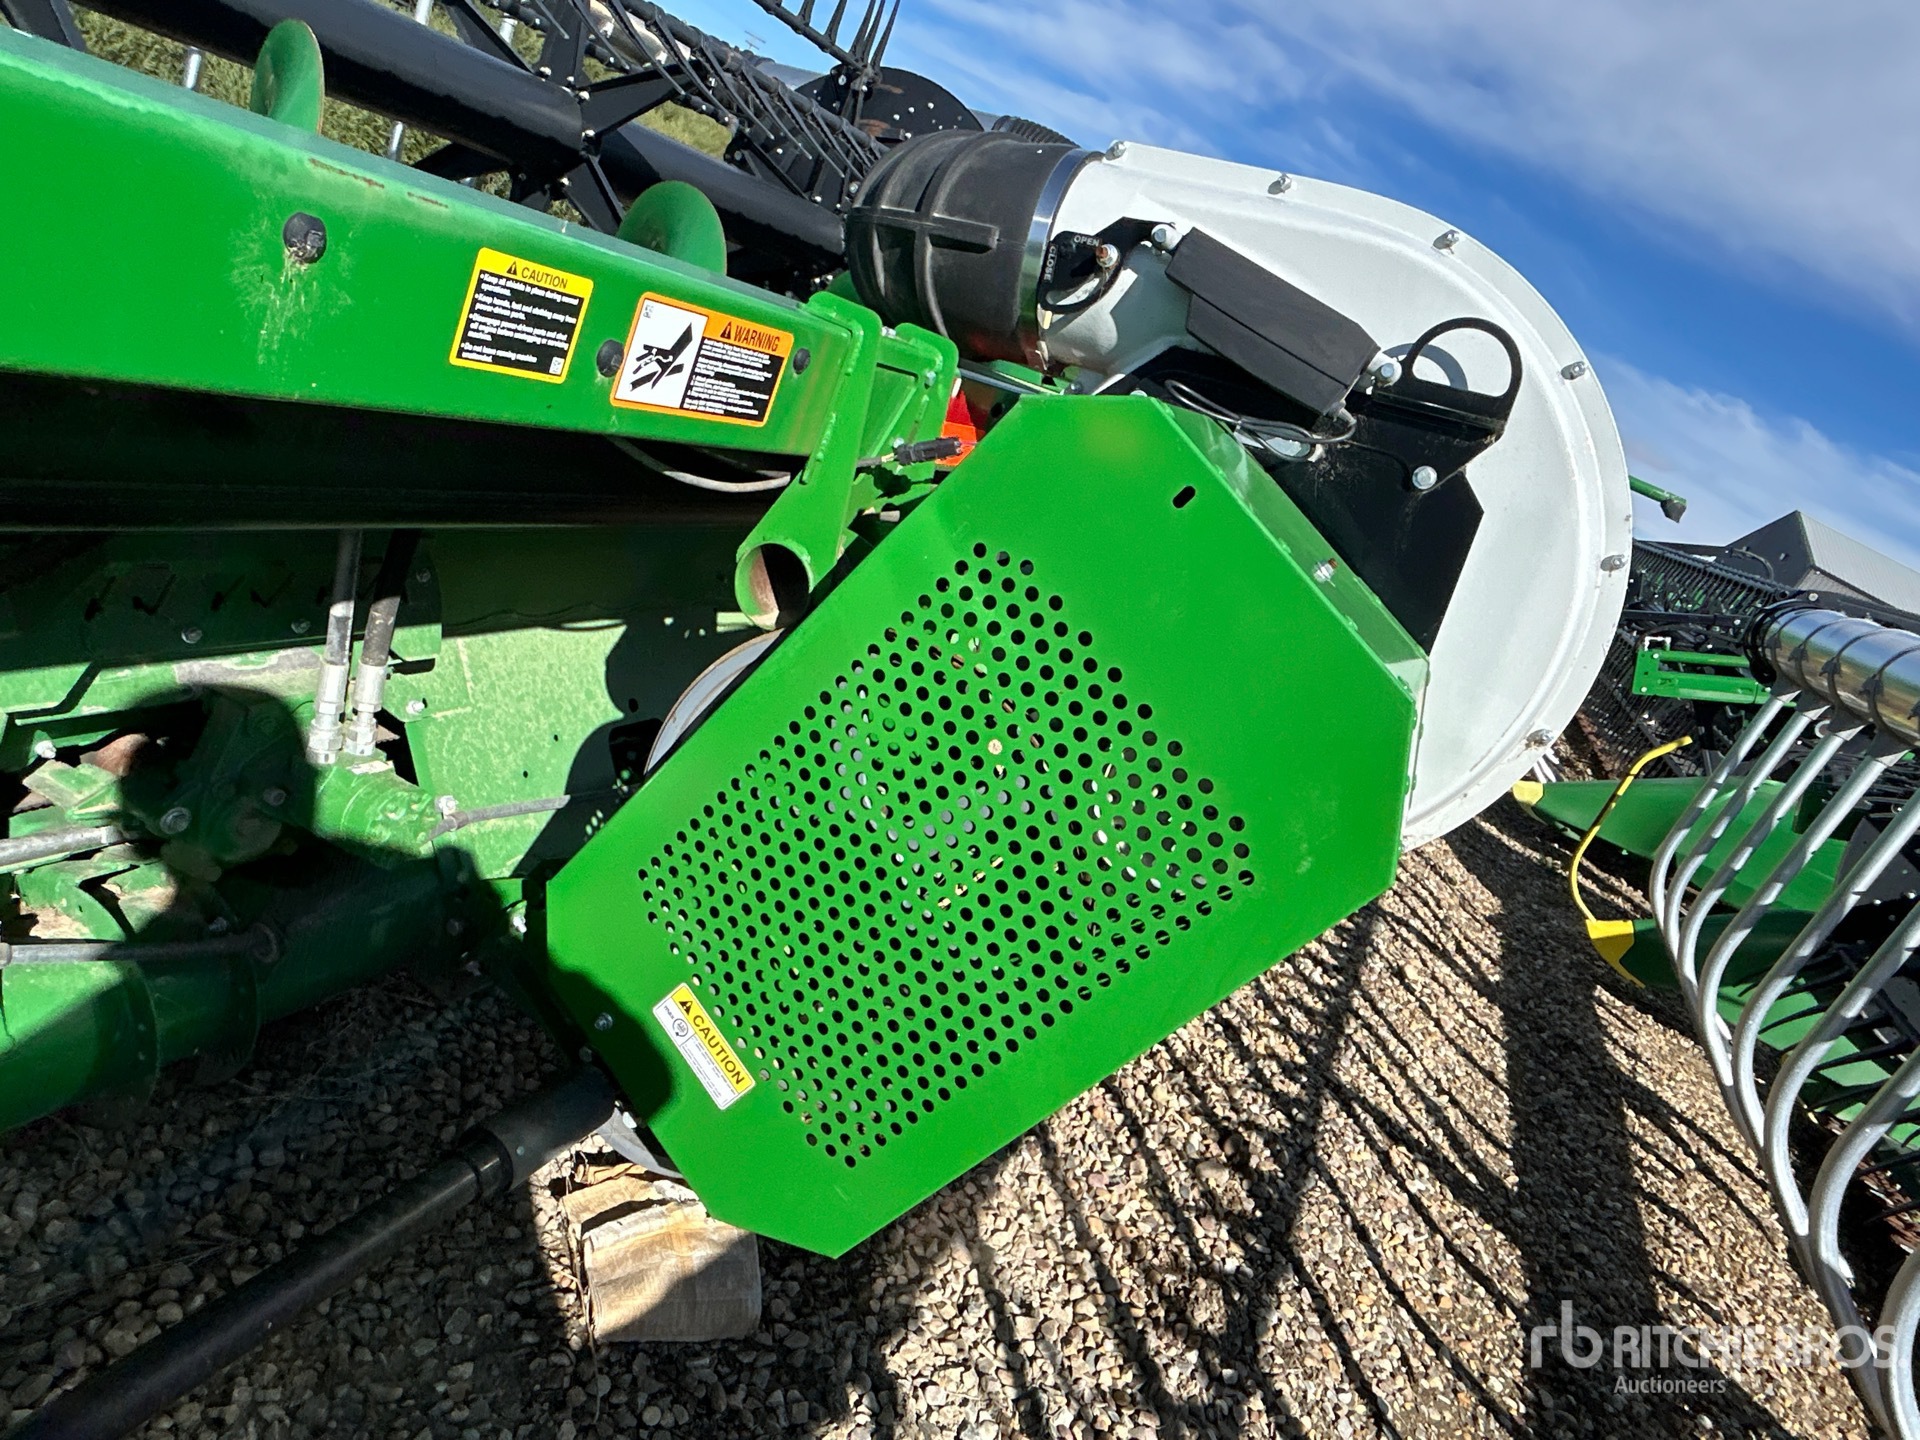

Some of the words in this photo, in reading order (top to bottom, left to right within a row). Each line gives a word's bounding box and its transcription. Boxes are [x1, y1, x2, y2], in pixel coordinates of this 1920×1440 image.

[1073, 235, 1100, 247] OPEN
[1043, 246, 1057, 281] CLOSE
[521, 267, 568, 289] CAUTION
[734, 325, 780, 352] WARNING
[693, 1015, 745, 1085] CAUTION
